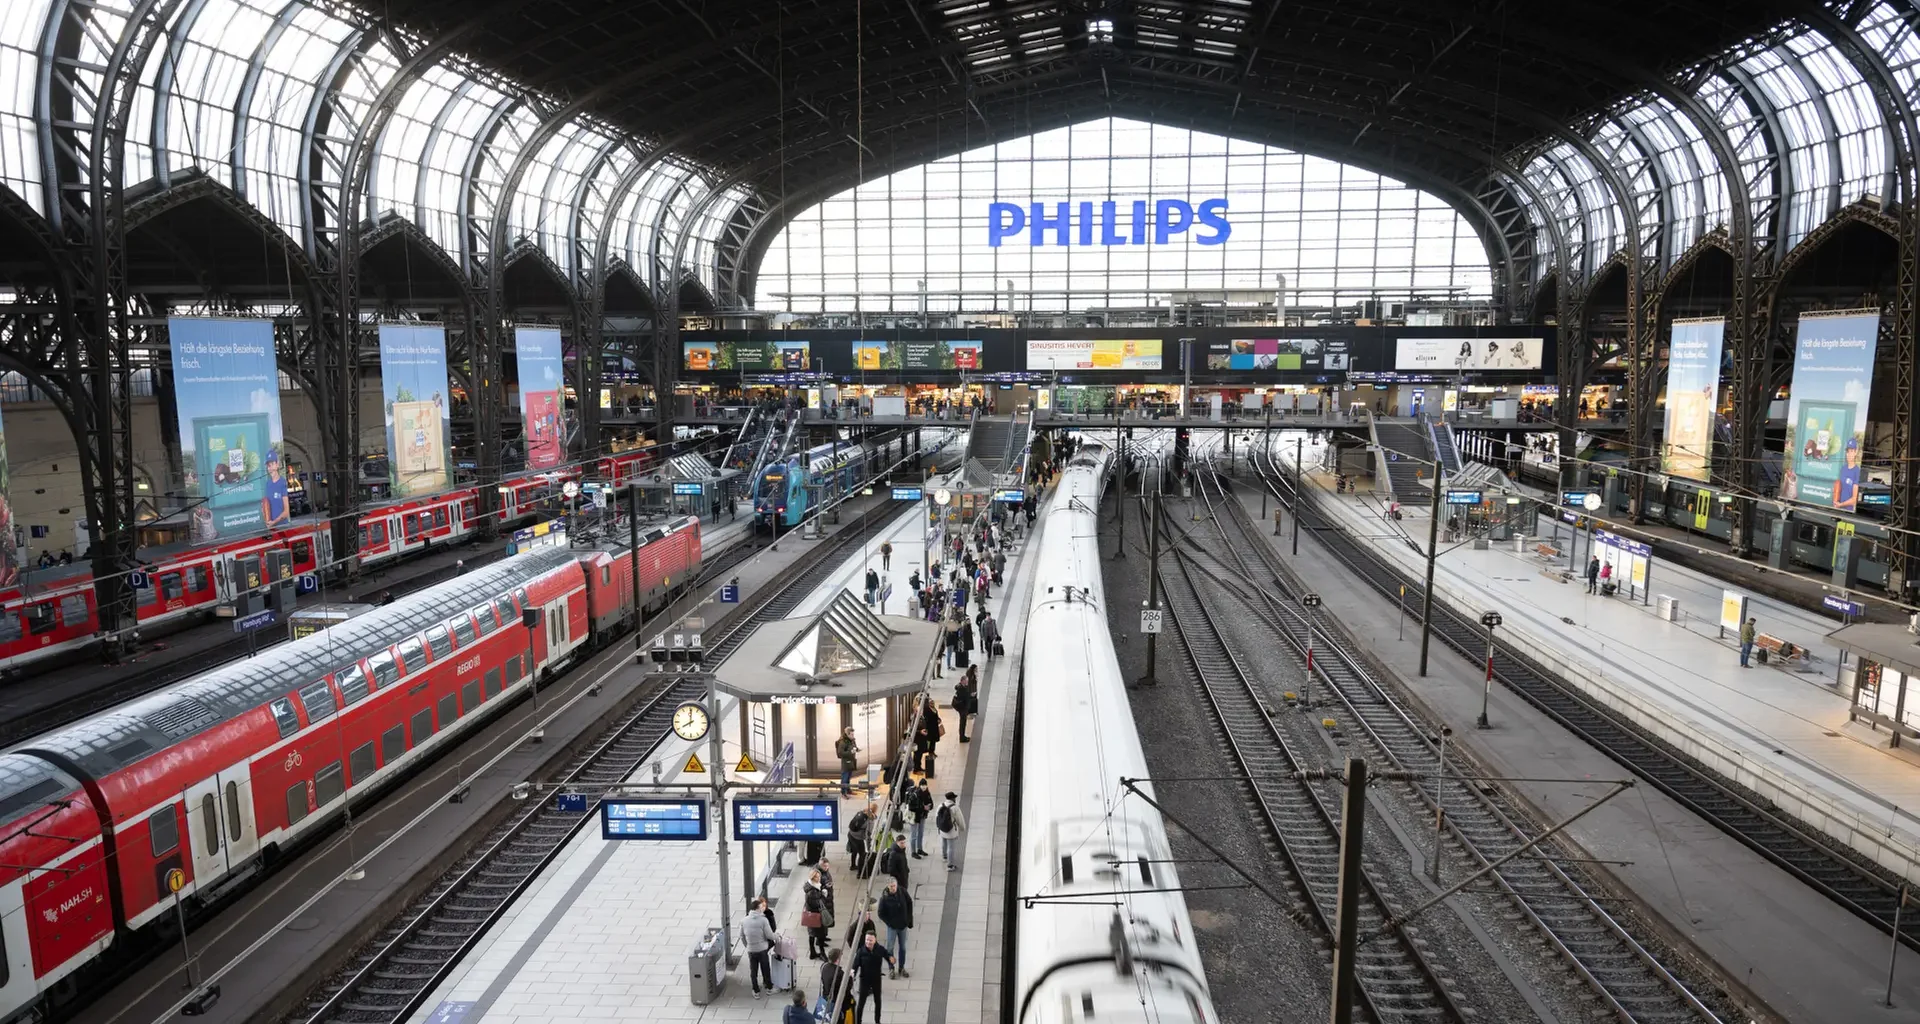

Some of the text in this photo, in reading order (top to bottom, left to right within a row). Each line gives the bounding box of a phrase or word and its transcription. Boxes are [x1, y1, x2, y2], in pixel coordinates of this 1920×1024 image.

[988, 198, 1232, 247] PHILIPS
[180, 341, 265, 357] Hält die längste Beziehung
[1029, 342, 1095, 350] SINUSITIS HEVERT
[132, 572, 142, 586] D
[304, 576, 314, 589] D
[723, 587, 732, 600] E
[1823, 597, 1842, 610] Hamburg
[1142, 611, 1160, 621] 286
[242, 618, 262, 629] Hamburg
[1148, 621, 1154, 631] 6
[456, 658, 474, 677] REGIO
[770, 695, 824, 705] ServiceStore
[308, 780, 313, 793] 2
[612, 804, 620, 815] 7
[824, 805, 832, 816] 8
[60, 886, 93, 914] NAH.SH
